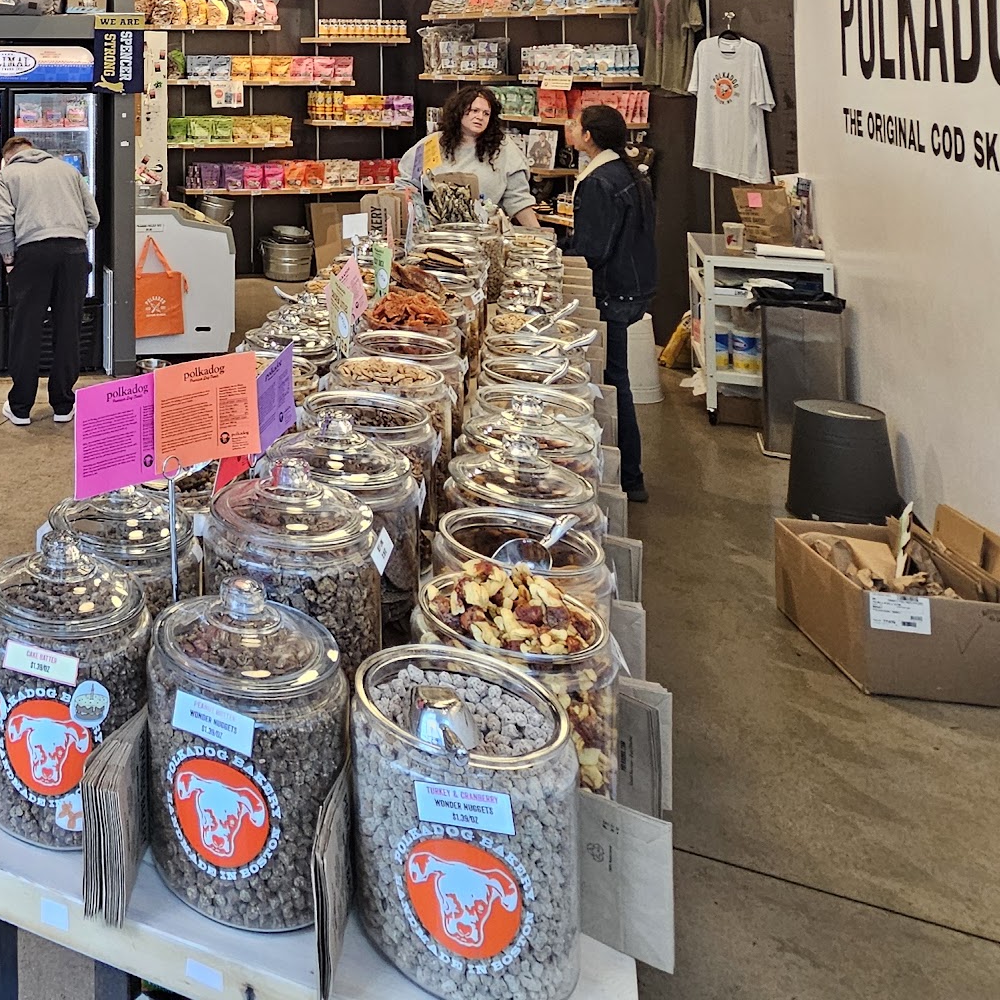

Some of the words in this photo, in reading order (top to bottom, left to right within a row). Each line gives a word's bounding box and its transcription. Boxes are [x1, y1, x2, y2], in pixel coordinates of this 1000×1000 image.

[100, 18, 117, 26] WE
[119, 18, 140, 26] ARE
[103, 33, 116, 77] STRONG
[120, 31, 133, 82] SPENCER
[843, 107, 863, 137] THE
[867, 112, 926, 153] ORIGINAL
[931, 123, 965, 163] COD
[183, 364, 226, 381] polkadog
[106, 383, 149, 402] polkadog
[26, 650, 38, 659] CAKE
[40, 653, 57, 664] BATTER
[190, 709, 212, 724] WONDER
[213, 719, 238, 735] NUGGETS
[166, 746, 229, 784] POLKADOG
[232, 756, 282, 820] BAKERY
[426, 786, 451, 797] TURKEY
[453, 790, 459, 799] &
[460, 790, 499, 804] CRANBERRY
[434, 798, 462, 811] WONDER
[463, 804, 494, 816] NUGGETS
[166, 791, 217, 878] HANDMADE
[219, 870, 238, 881] IN
[241, 826, 281, 880] BOSTON
[395, 824, 475, 865] POLKADOG
[478, 828, 535, 901] BAKERY
[394, 873, 463, 972] HANDMADE
[467, 963, 488, 975] IN
[492, 911, 535, 973] BOSTON
